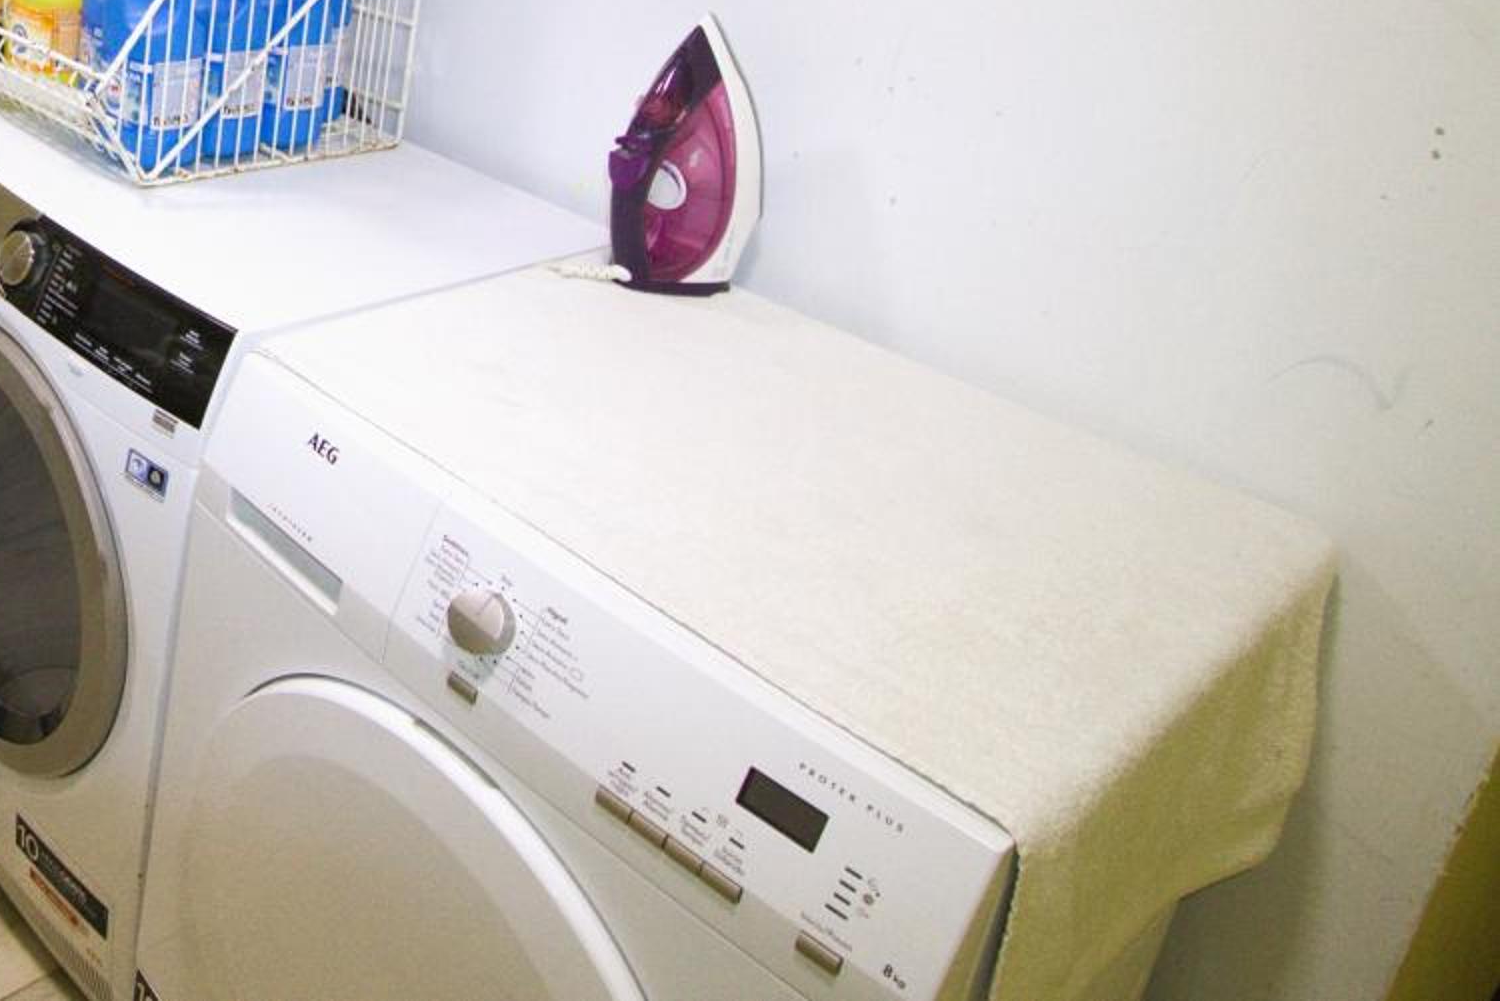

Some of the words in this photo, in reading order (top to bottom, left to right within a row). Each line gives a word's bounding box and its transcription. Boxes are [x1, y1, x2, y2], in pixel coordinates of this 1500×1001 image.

[307, 432, 340, 465] AEG
[866, 803, 904, 834] PLUS
[16, 824, 40, 862] 10
